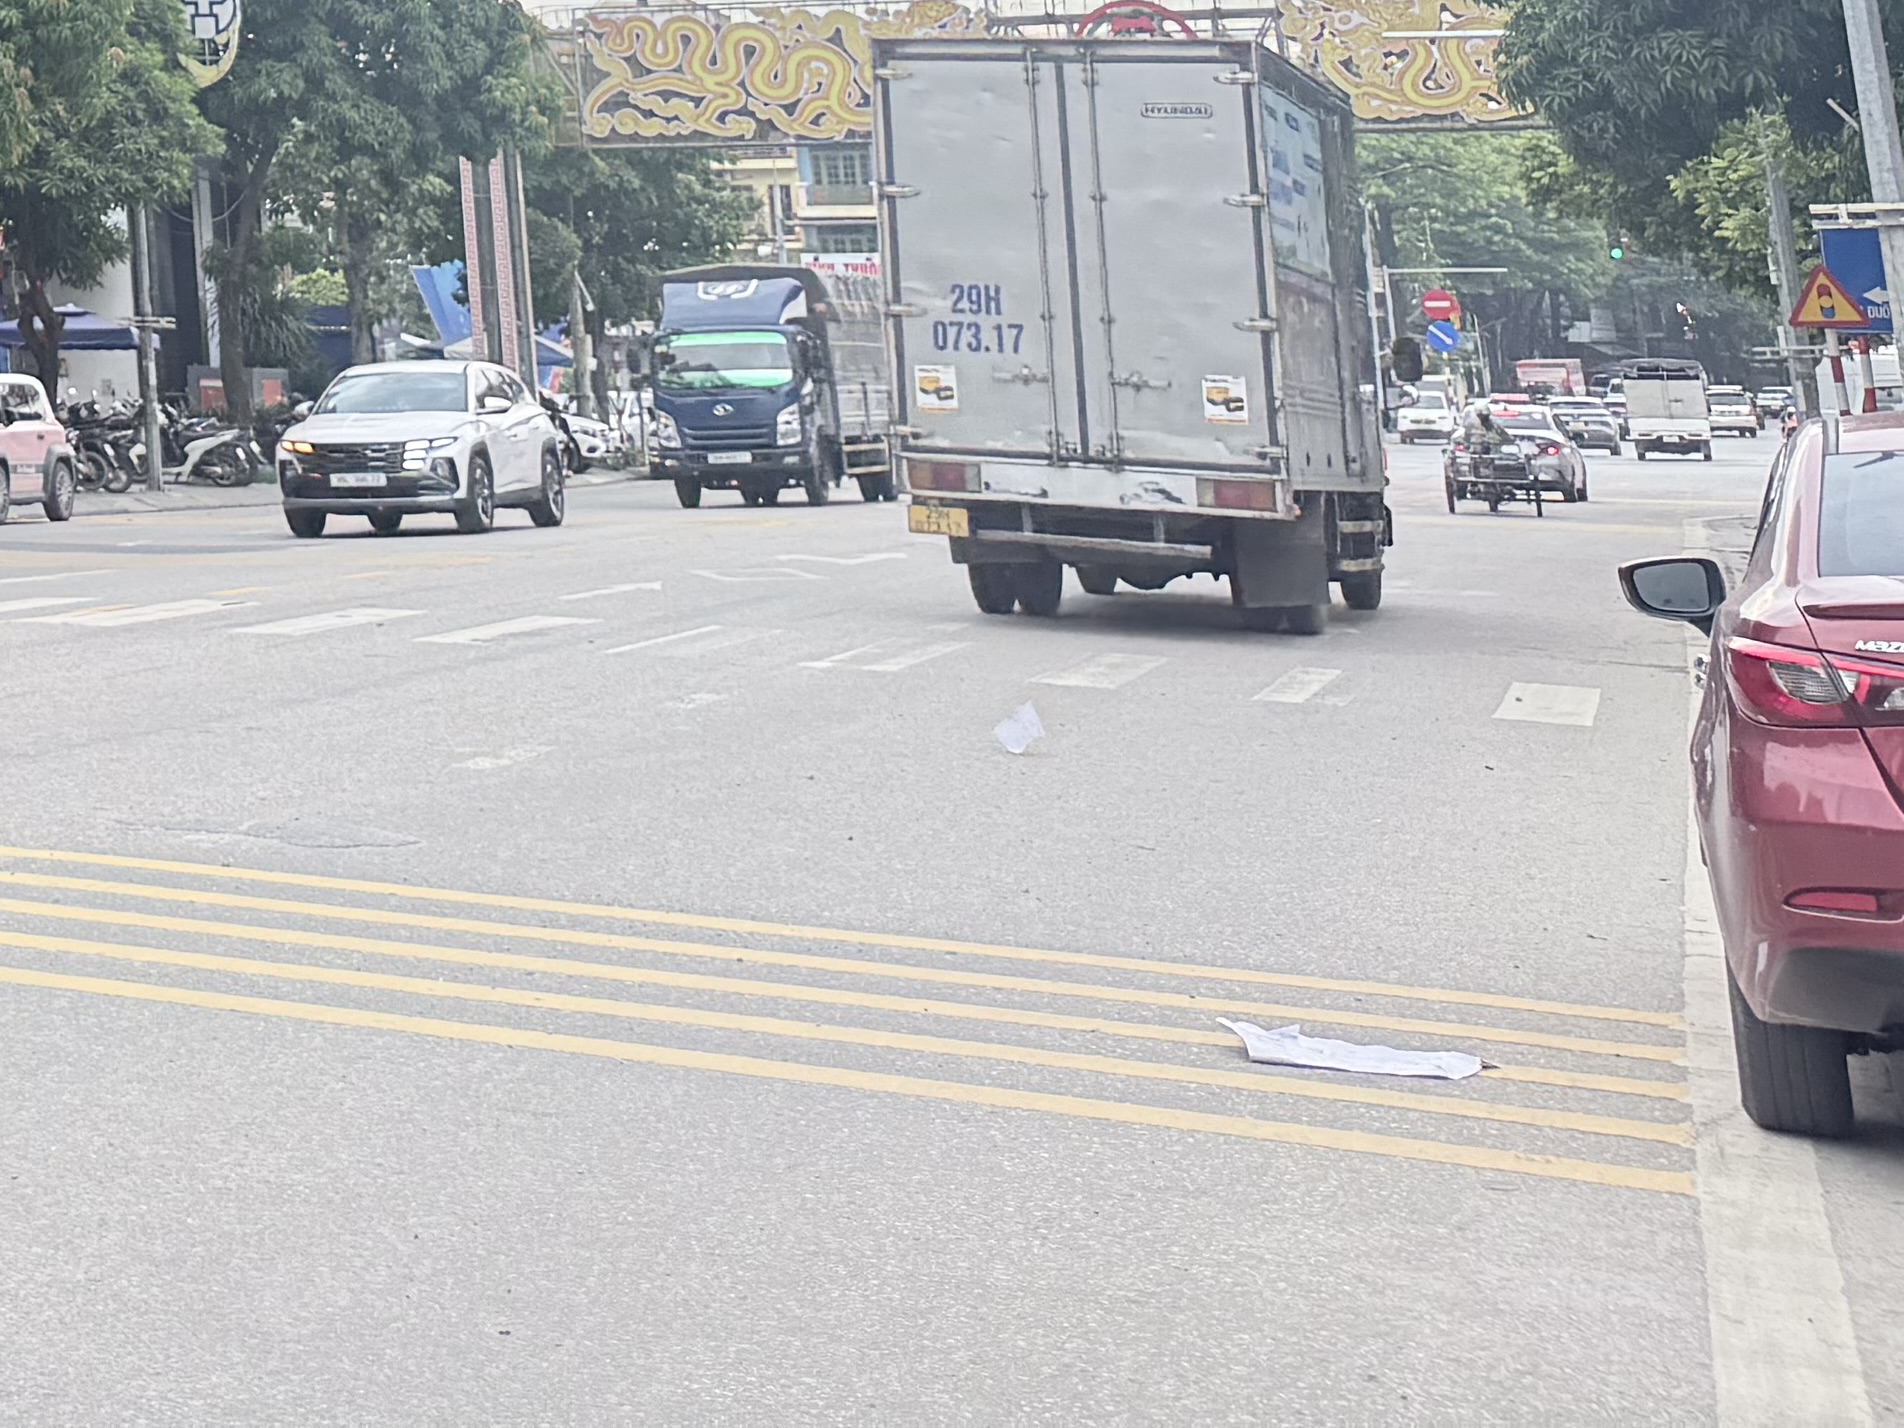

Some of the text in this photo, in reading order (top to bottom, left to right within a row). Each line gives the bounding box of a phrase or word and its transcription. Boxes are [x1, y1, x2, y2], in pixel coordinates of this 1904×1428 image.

[1144, 105, 1208, 116] HYUNDAI
[950, 284, 1003, 316] 29H
[933, 320, 1024, 354] 073.17
